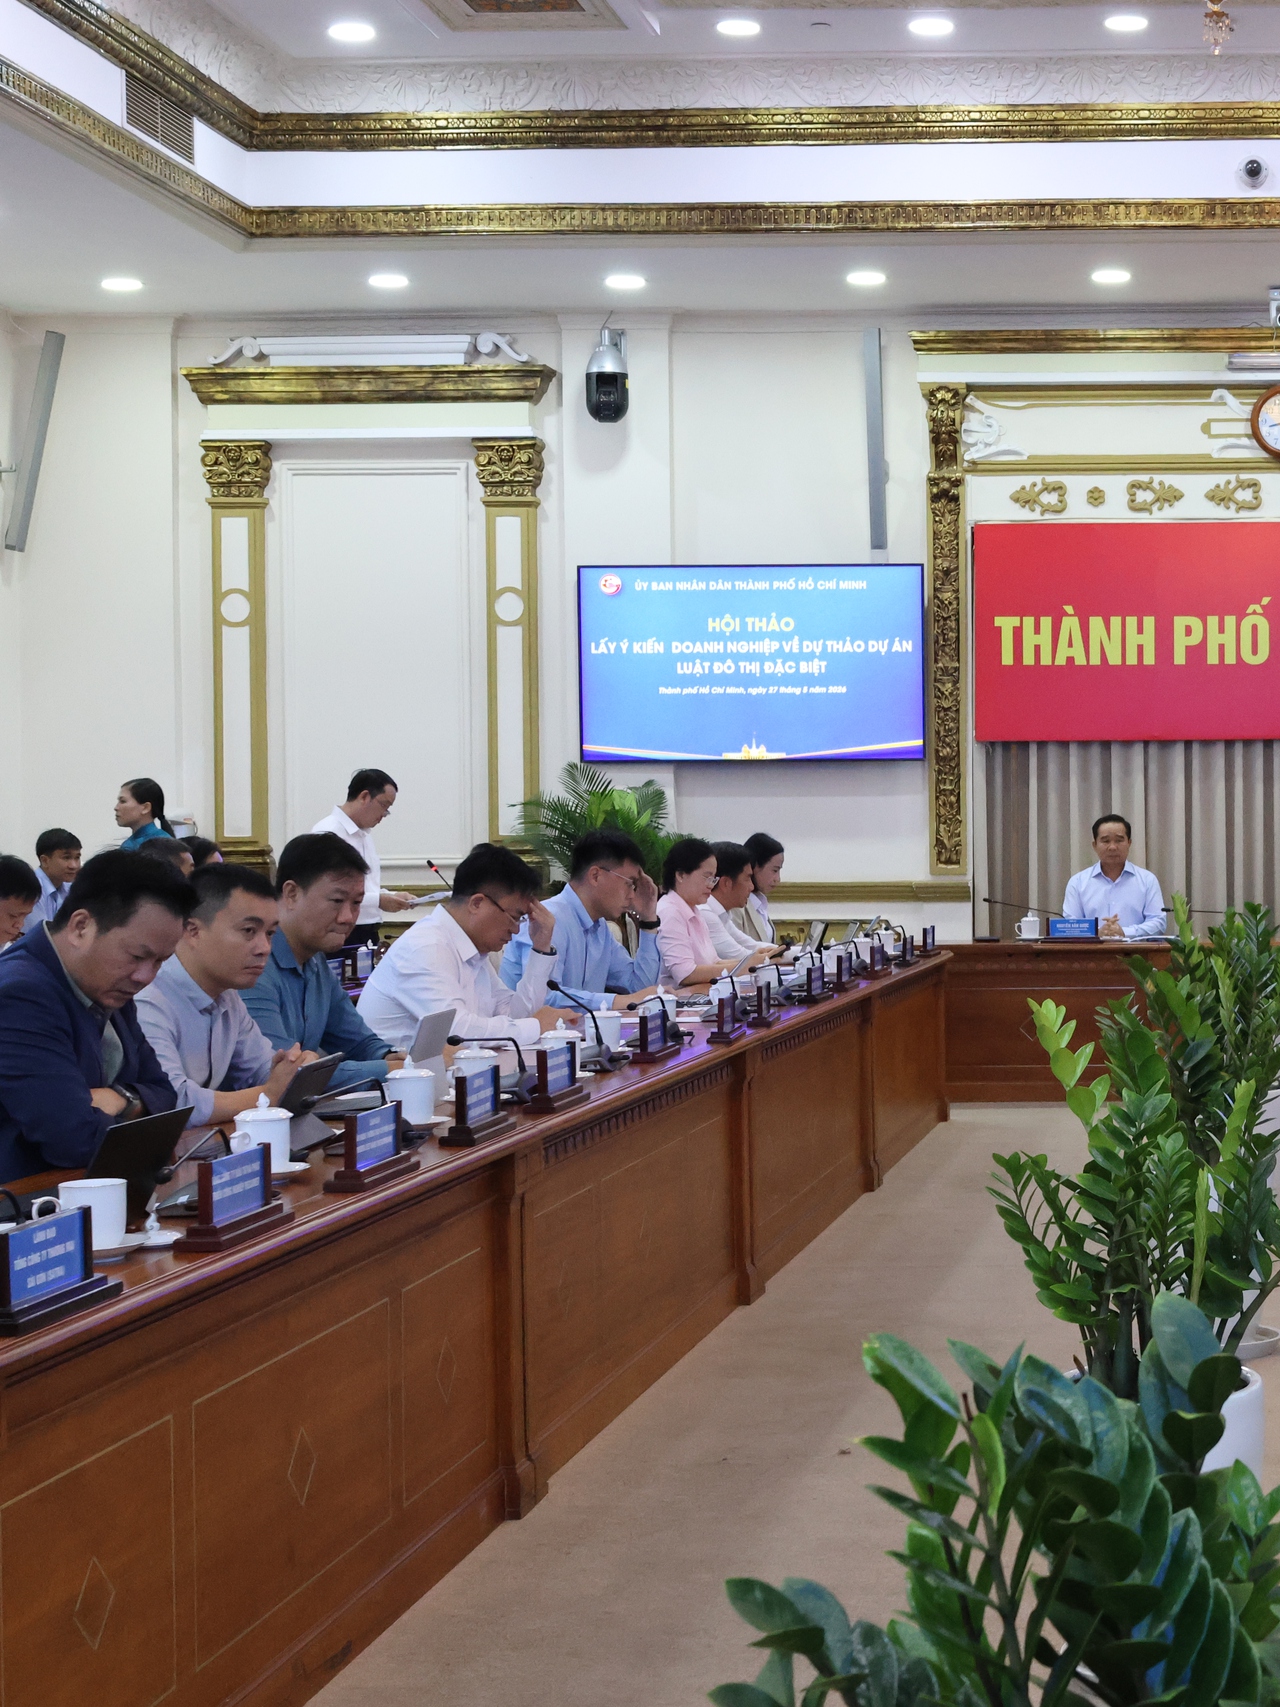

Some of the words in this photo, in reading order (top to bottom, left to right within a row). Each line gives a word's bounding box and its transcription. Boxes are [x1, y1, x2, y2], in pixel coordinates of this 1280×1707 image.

[635, 579, 648, 590] ỦY
[651, 582, 673, 590] BAN
[676, 579, 706, 590] NHÂN
[709, 579, 731, 590] DÂN
[734, 579, 769, 590] THÀNH
[773, 578, 796, 590] PHỐ
[798, 577, 814, 590] HỒ
[817, 579, 836, 590] CHÍ
[839, 581, 866, 589] MINH
[708, 614, 740, 636] HỘI
[746, 613, 795, 633] THẢO
[995, 606, 1155, 666] THÀNH
[1174, 597, 1271, 665] PHỐ
[591, 637, 616, 654] LẤY
[620, 639, 629, 653] Ý
[633, 637, 664, 653] KIẾN
[672, 641, 724, 653] DOANH
[727, 638, 780, 656] NGHIỆP
[782, 636, 799, 652] VỀ
[803, 639, 823, 655] DỰ
[826, 637, 865, 652] THẢO
[868, 639, 889, 655] DỰ
[892, 637, 912, 652] ÁN
[677, 659, 710, 677] LUẬT
[713, 659, 735, 674] ĐÔ
[738, 662, 760, 676] THỊ
[764, 659, 796, 676] ĐẶC
[800, 658, 827, 676] BIỆT
